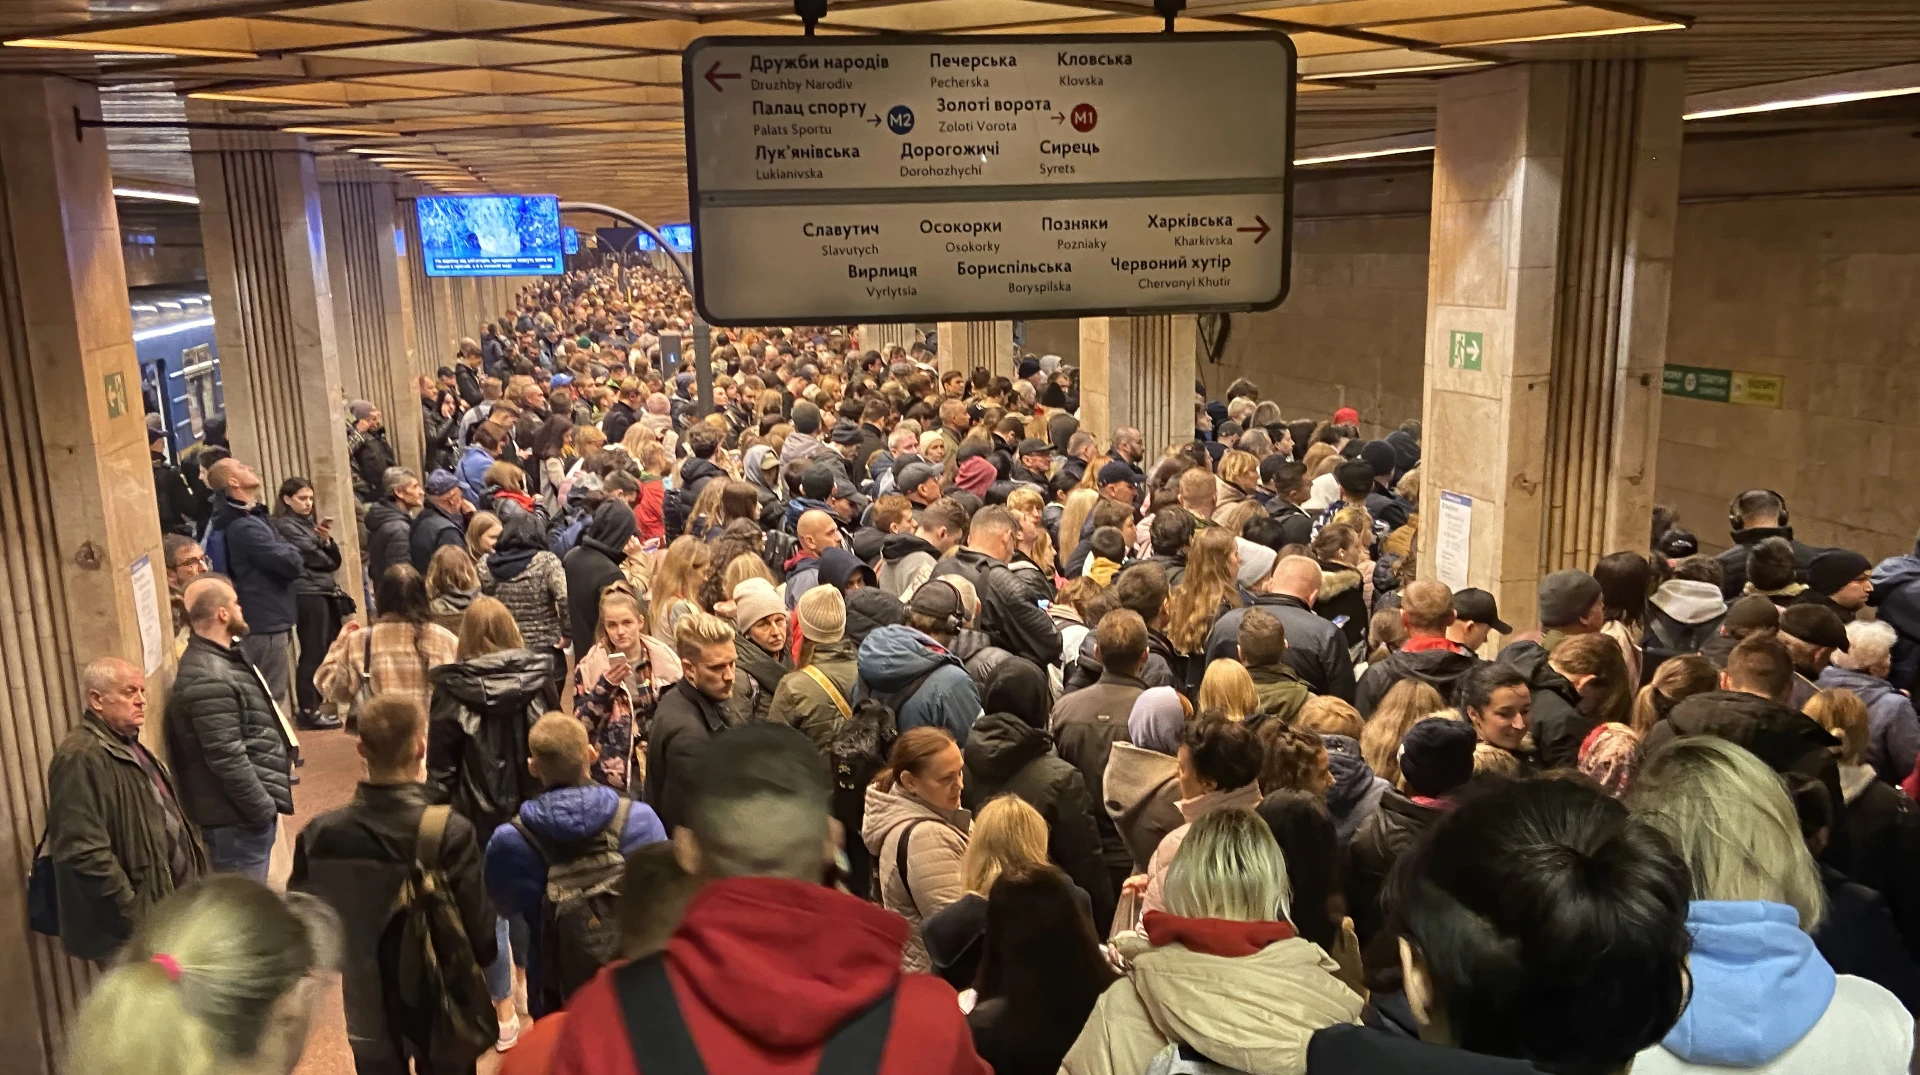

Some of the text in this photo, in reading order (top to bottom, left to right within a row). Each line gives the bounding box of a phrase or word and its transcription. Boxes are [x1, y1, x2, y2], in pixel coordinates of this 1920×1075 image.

[750, 53, 890, 75] Дружби народів
[930, 53, 1017, 72] Печерська
[1057, 51, 1132, 66] Кловська
[751, 78, 853, 93] Druzhby Narodiv
[930, 76, 990, 89] Pecherska
[1059, 75, 1104, 87] Klovska
[752, 100, 867, 118] Палац спорту
[936, 96, 1052, 116] Золоті ворота
[889, 113, 912, 128] M2
[1074, 111, 1094, 125] M1
[753, 123, 832, 137] Palats Sportu
[939, 120, 1018, 133] Zoloti Vorota
[755, 144, 860, 161] Лук'янівська
[901, 140, 1000, 161] Дорогожичі
[1040, 139, 1100, 159] Сирець
[756, 168, 824, 180] Lukianivska
[900, 164, 982, 179] Dorohozhychi
[1040, 163, 1076, 177] Syrets
[919, 219, 1002, 237] Осокорки
[1042, 216, 1109, 232] Позняки
[1148, 213, 1233, 233] Харківська
[803, 222, 879, 240] Славутич
[945, 241, 1001, 255] Osokorky
[1057, 238, 1107, 252] Pozniaky
[1174, 235, 1233, 247] Kharkivska
[822, 244, 879, 259] Slavutych
[958, 260, 1072, 279] Бориспільська
[1111, 254, 1232, 275] Червоний хутір
[849, 264, 918, 282] Вирлиця
[1008, 280, 1072, 295] Boryspilska
[1138, 276, 1231, 290] Chervonyi Khutir
[866, 286, 918, 300] Vyrlytsia
